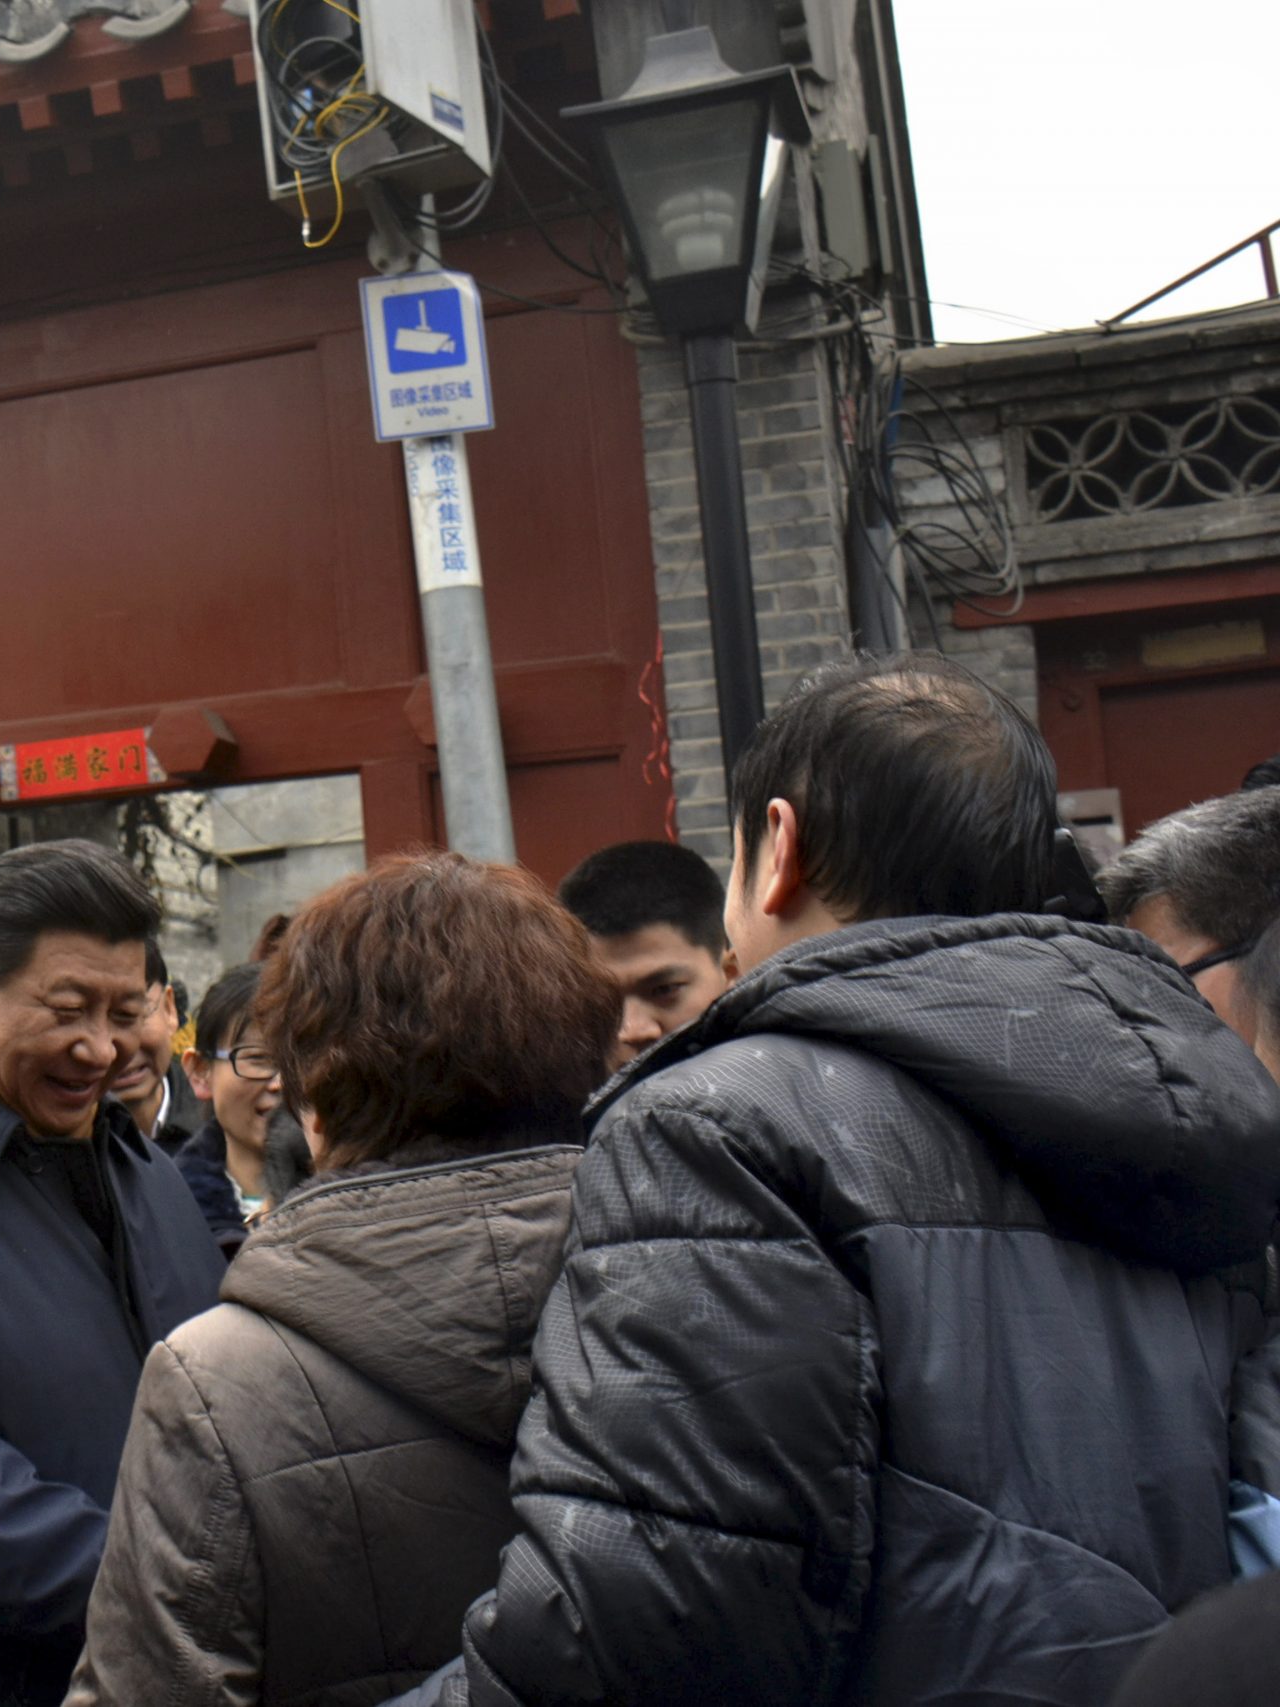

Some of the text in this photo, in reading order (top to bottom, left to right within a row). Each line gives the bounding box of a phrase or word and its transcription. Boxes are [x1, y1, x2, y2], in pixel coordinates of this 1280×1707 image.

[389, 380, 473, 408] 图像采集区域
[417, 406, 450, 418] Video
[23, 745, 142, 785] 福满家门
